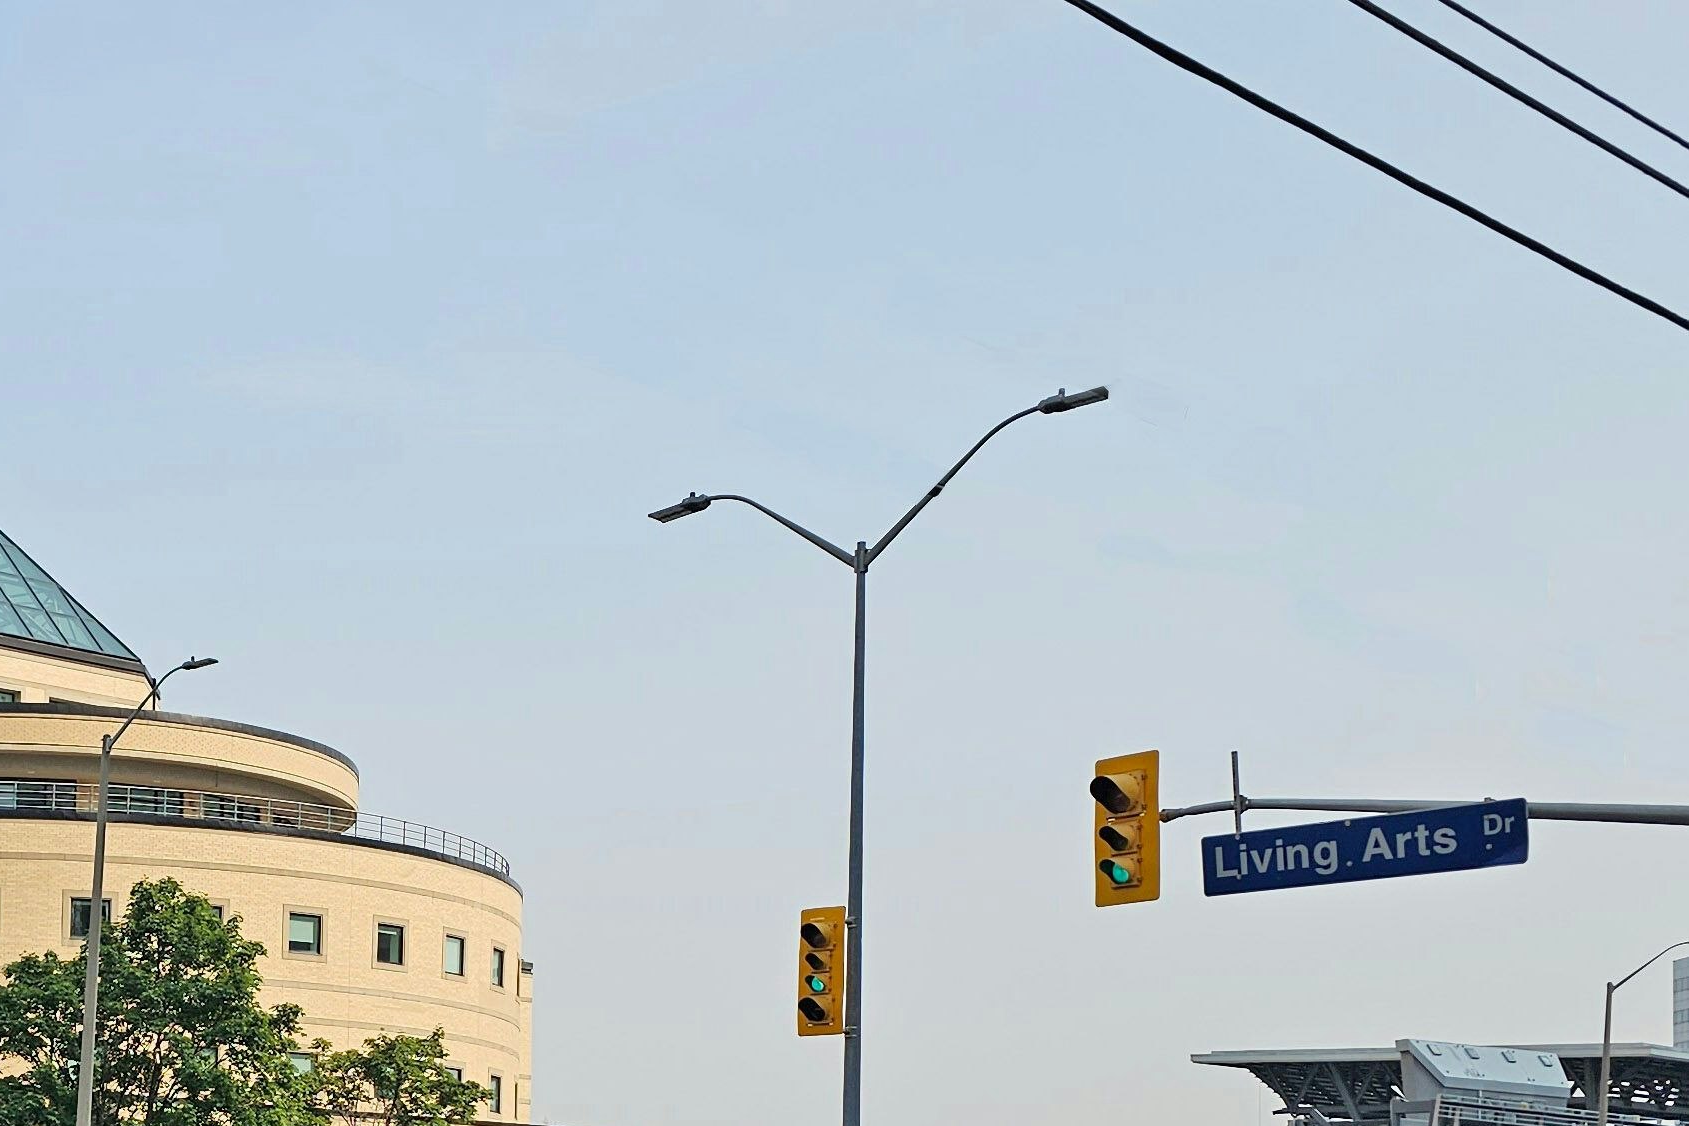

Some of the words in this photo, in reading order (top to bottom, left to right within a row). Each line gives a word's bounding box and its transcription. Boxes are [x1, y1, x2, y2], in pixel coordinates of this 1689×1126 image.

[1215, 839, 1339, 876] Living
[1361, 825, 1458, 863] Arts
[1483, 813, 1515, 836] Dr
